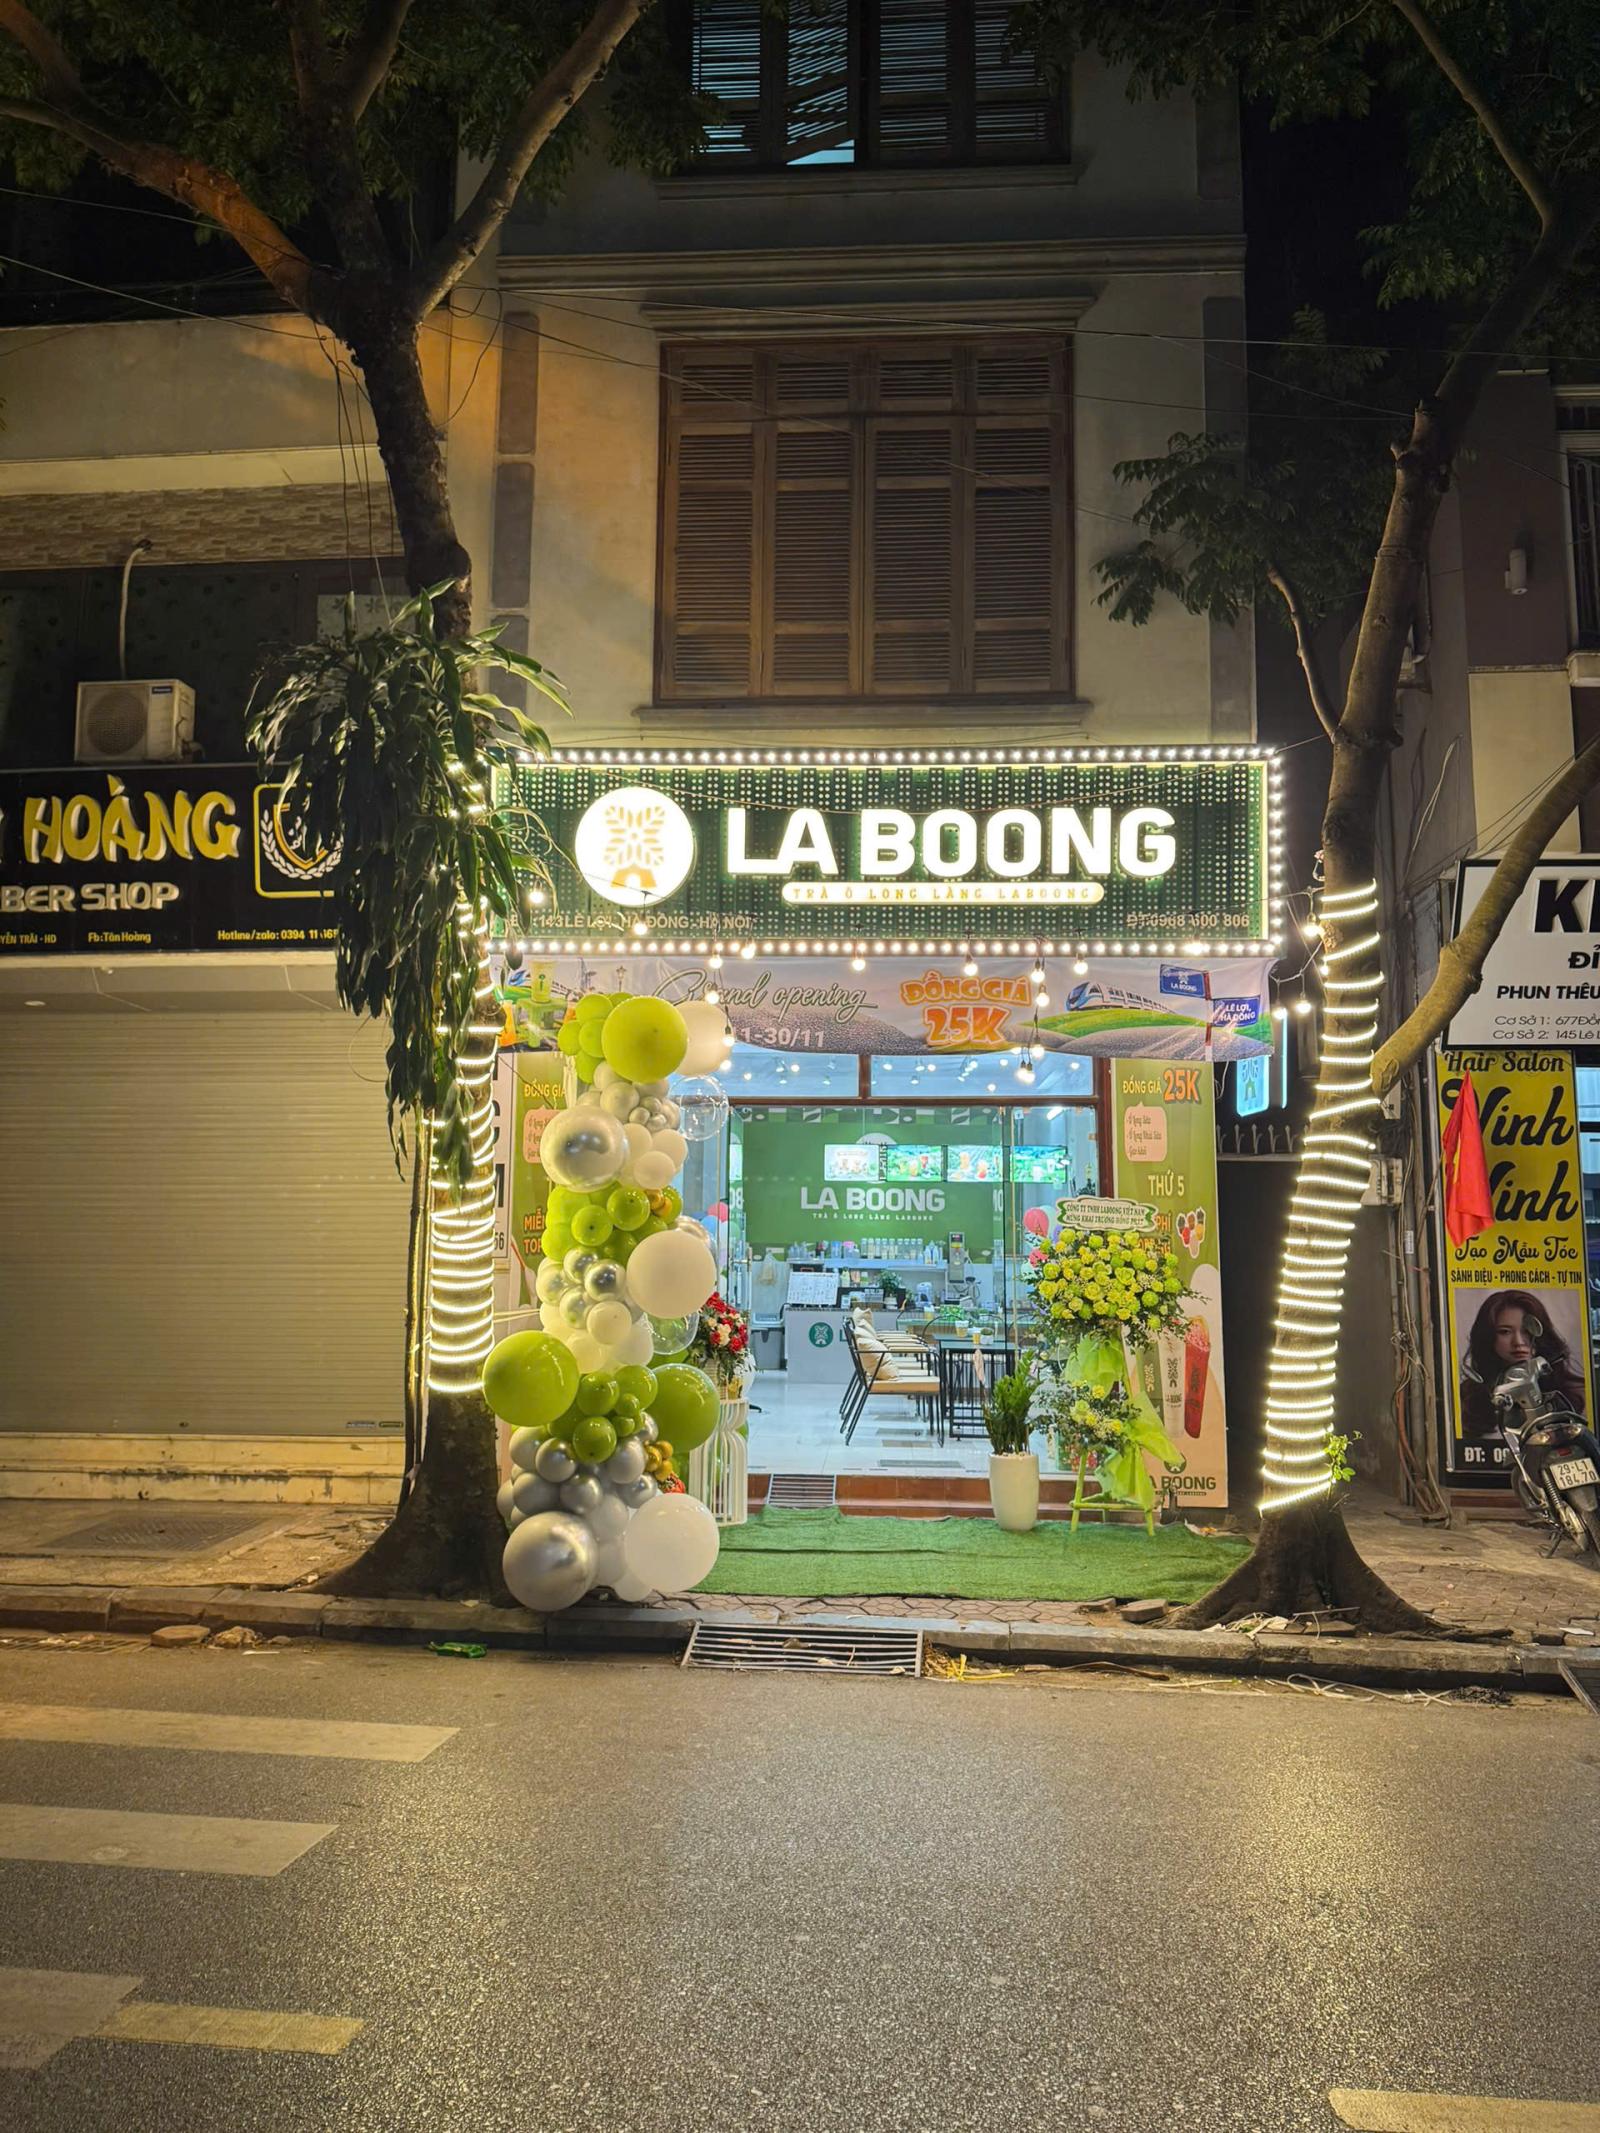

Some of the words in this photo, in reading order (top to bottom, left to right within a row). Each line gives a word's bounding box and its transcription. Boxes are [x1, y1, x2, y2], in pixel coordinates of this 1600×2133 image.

[24, 774, 240, 863] HOÀNG
[727, 807, 838, 875] LA
[860, 807, 1176, 878] BOONG
[81, 881, 180, 911] SHOP
[793, 885, 828, 899] TRÀ
[869, 888, 918, 899] LONG
[932, 886, 982, 899] LÀNG
[997, 888, 1089, 899] LABOONG
[1223, 914, 1250, 927] 806
[121, 931, 151, 944] Hoàng
[773, 983, 879, 1024] opening
[981, 976, 1032, 1007] GIÁ
[1496, 985, 1551, 999] PHUN
[924, 1004, 1012, 1046] 25K
[1494, 1015, 1516, 1025] Cơ
[1493, 1030, 1514, 1039] Cơ
[1556, 1030, 1577, 1039] 145
[1445, 1051, 1496, 1072] Hair
[1502, 1051, 1565, 1072] Salon
[1163, 1068, 1200, 1102] 25K
[1148, 1168, 1174, 1196] THỨ
[1177, 1175, 1185, 1196] 5
[800, 1186, 839, 1210] LA
[846, 1188, 946, 1212] BOONG
[1544, 1236, 1578, 1262] Tóc
[1500, 1270, 1527, 1283] PHONG
[1529, 1268, 1550, 1283] CÁCH
[1569, 1271, 1583, 1284] TIN
[1161, 1475, 1217, 1490] BOONG
